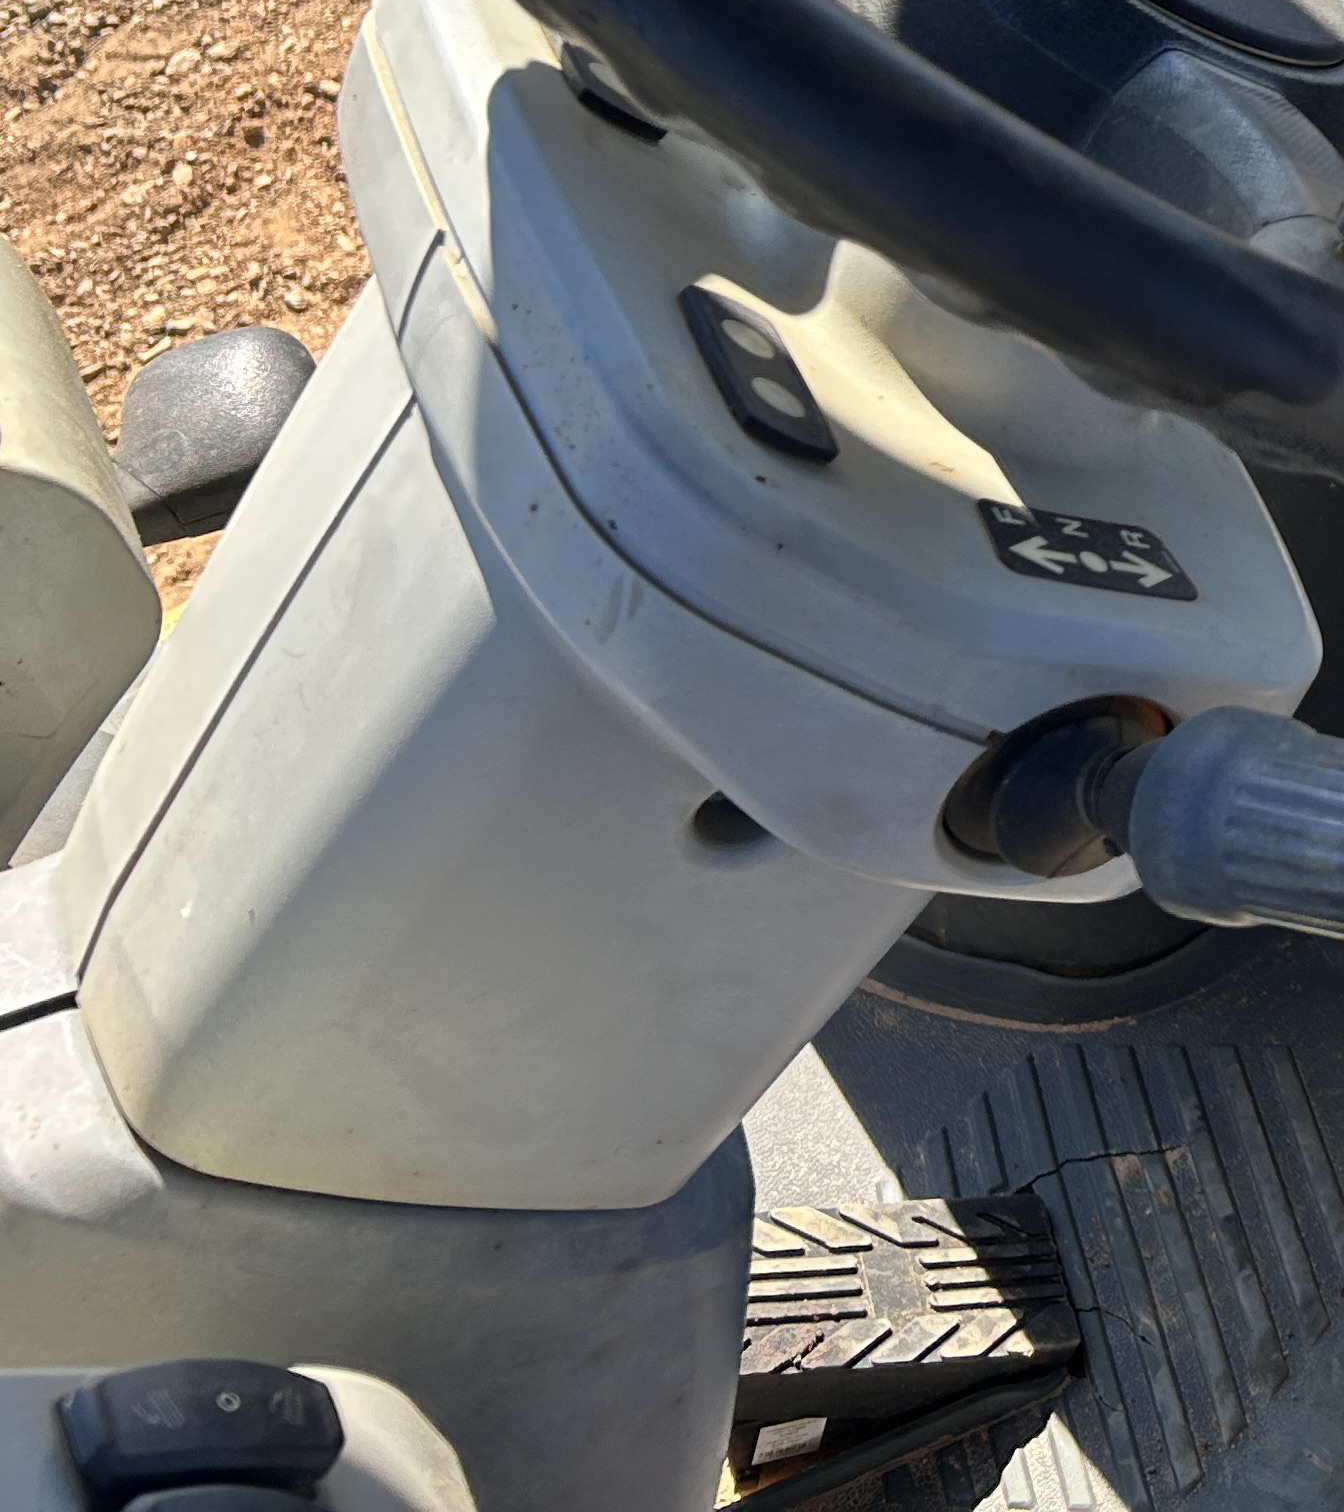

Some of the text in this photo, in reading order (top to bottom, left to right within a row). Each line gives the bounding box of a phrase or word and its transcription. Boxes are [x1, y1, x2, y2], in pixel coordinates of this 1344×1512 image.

[991, 506, 1151, 550] F N R
